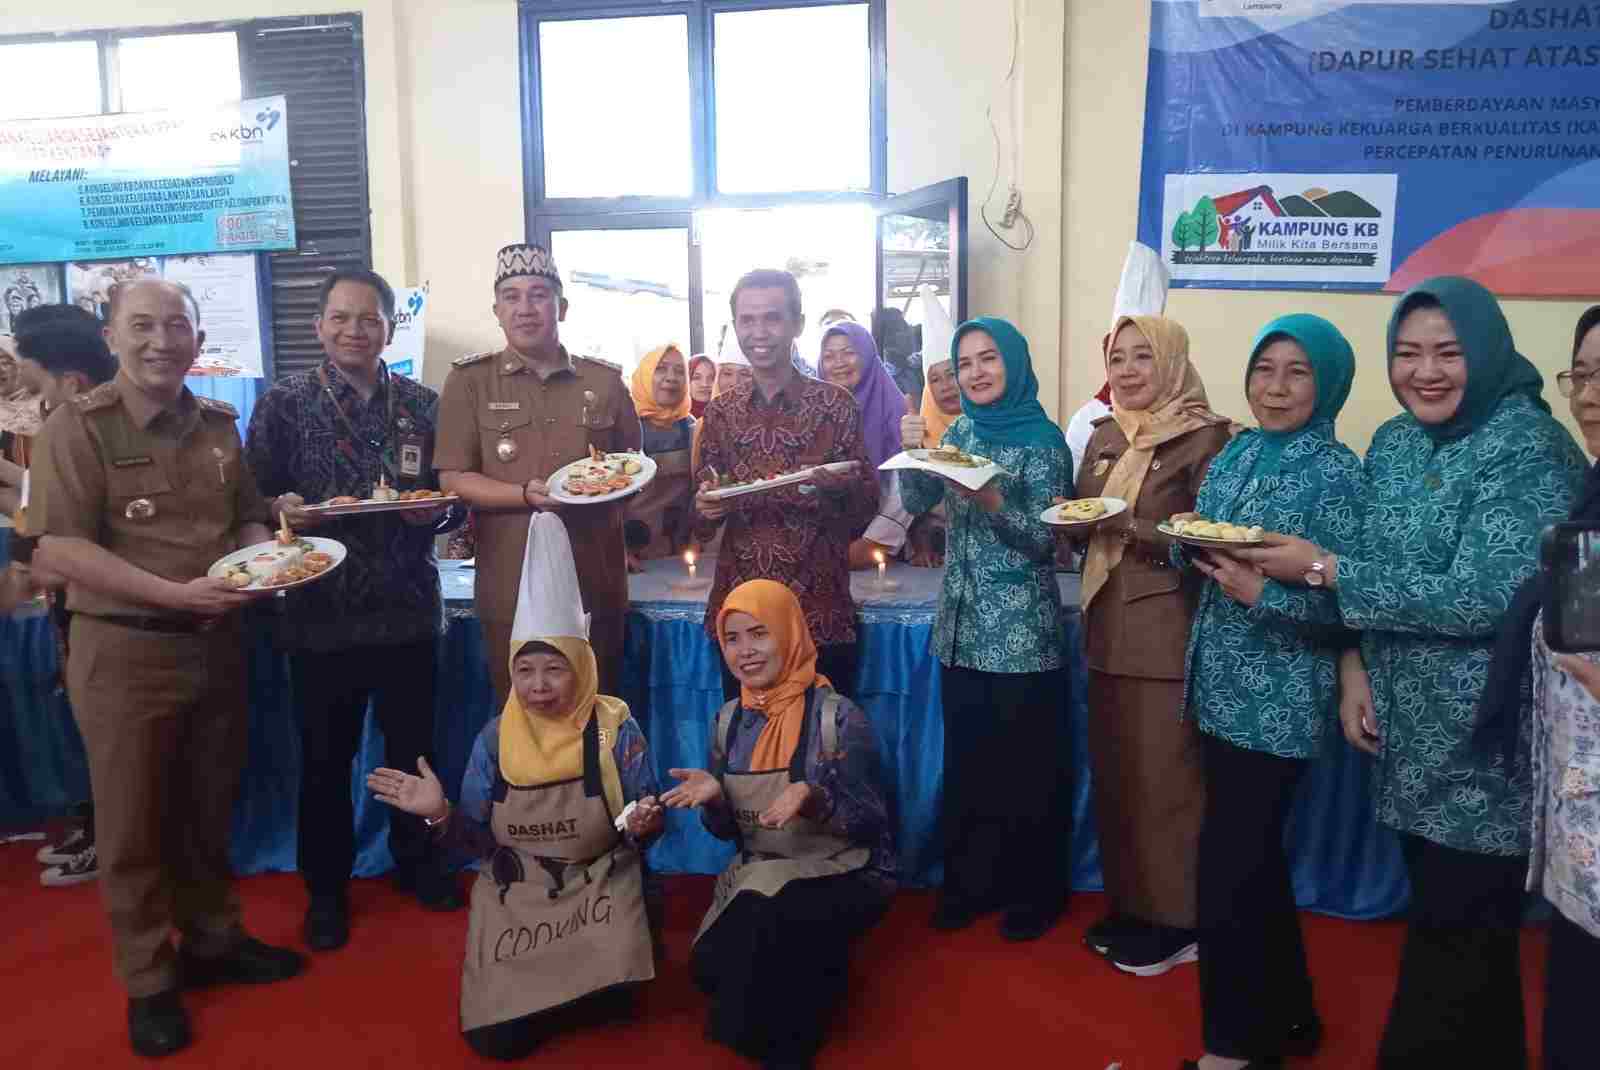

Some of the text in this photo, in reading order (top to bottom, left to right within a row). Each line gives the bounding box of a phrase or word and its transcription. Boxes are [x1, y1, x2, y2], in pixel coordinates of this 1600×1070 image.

[1424, 48, 1513, 70] SEHAT
[1525, 45, 1600, 67] ATAS
[1394, 96, 1545, 112] PEMBERDAYAAN
[1246, 122, 1333, 137] KAMPUNG
[1338, 121, 1432, 136] KEKUARGA
[1439, 120, 1561, 136] BERKUALITAS
[1363, 143, 1600, 160] PERCEPATAN PENURUNAN
[29, 167, 88, 183] MELAYANI:
[1258, 221, 1379, 237] KAMPUNG KB
[1257, 239, 1378, 250] Milik Kita Bersama
[506, 817, 577, 836] DASHAT
